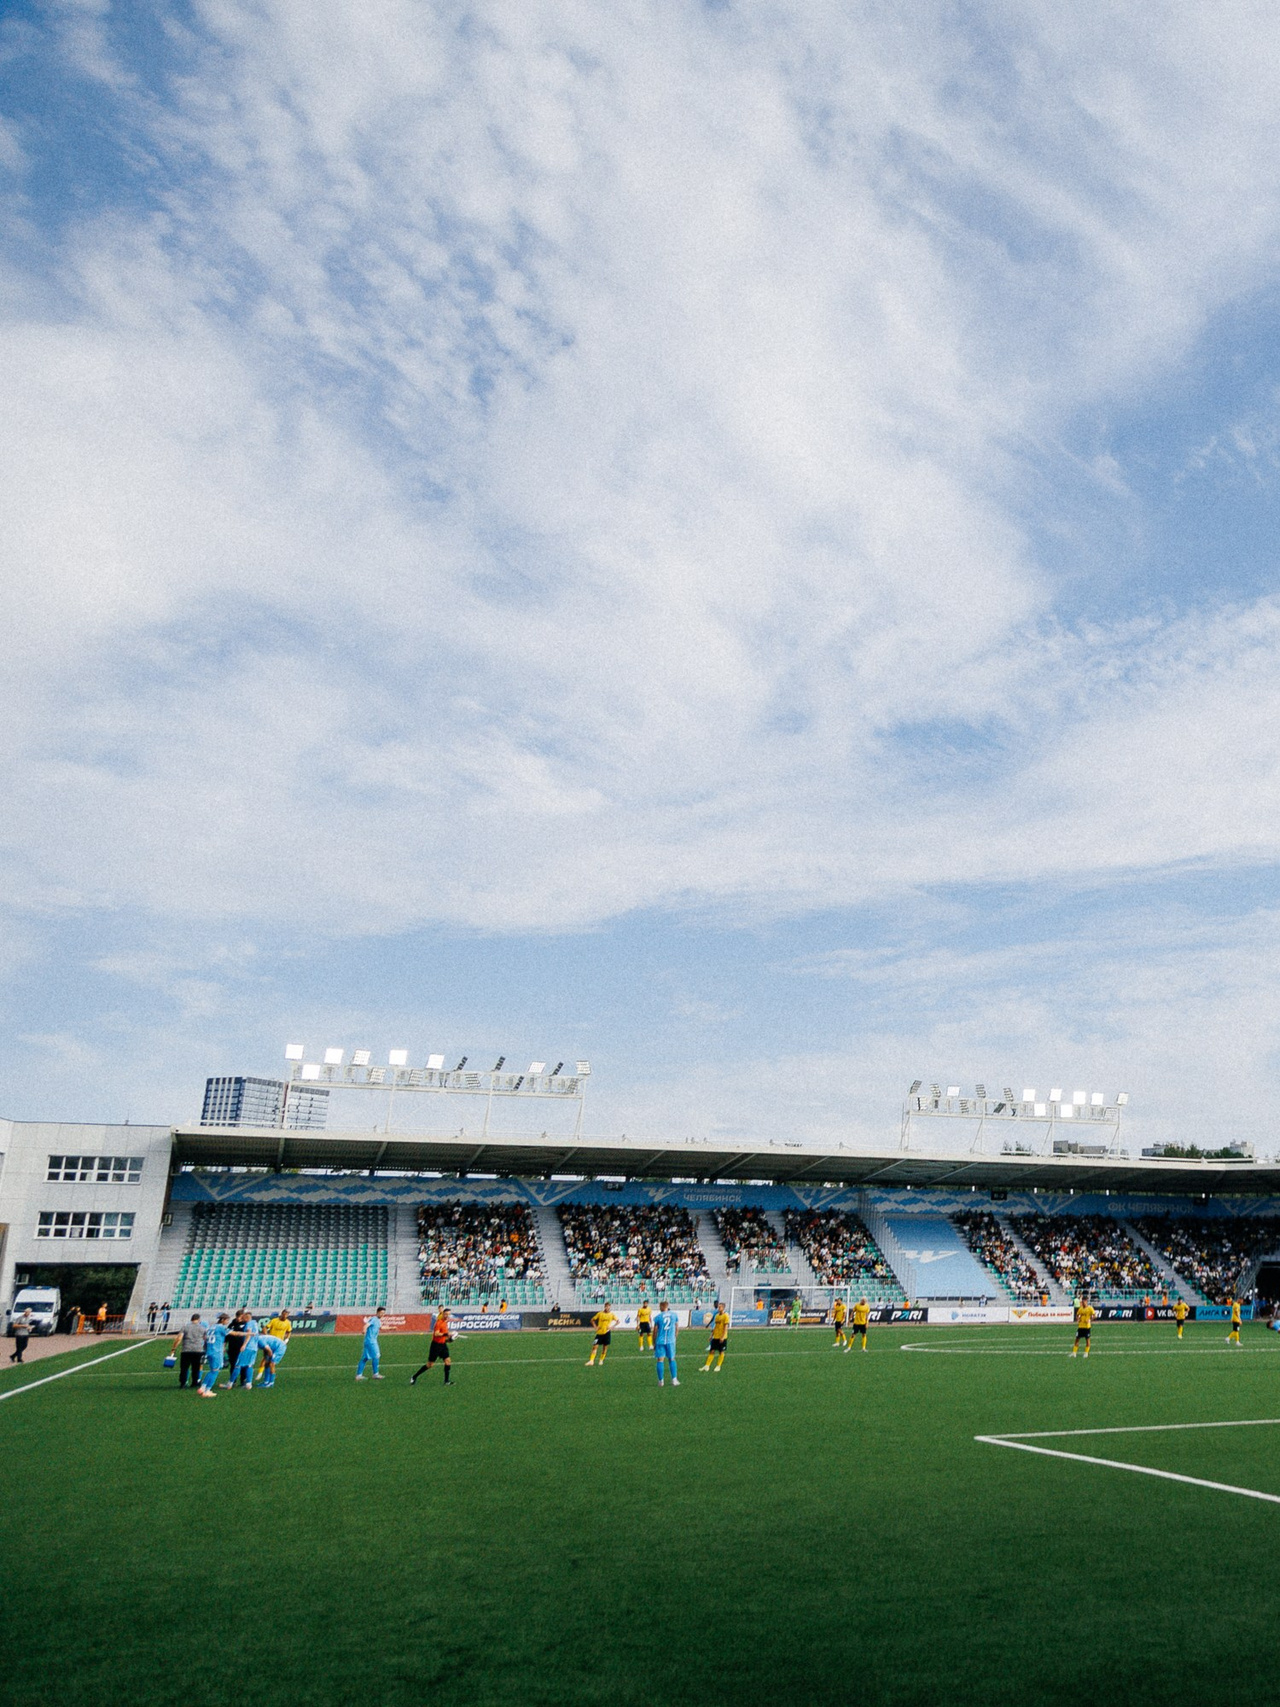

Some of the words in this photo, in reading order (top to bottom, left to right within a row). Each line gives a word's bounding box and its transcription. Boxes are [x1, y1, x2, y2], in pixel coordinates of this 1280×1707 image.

[683, 1194, 742, 1203] ЧЕЛЯБИНСК
[1107, 1202, 1126, 1212] ФК
[1127, 1202, 1194, 1213] ЧЕЛЯБИНСК
[891, 1310, 923, 1320] PARI
[1108, 1310, 1133, 1318] PARI
[1157, 1309, 1167, 1317] VK
[663, 1317, 671, 1330] 2
